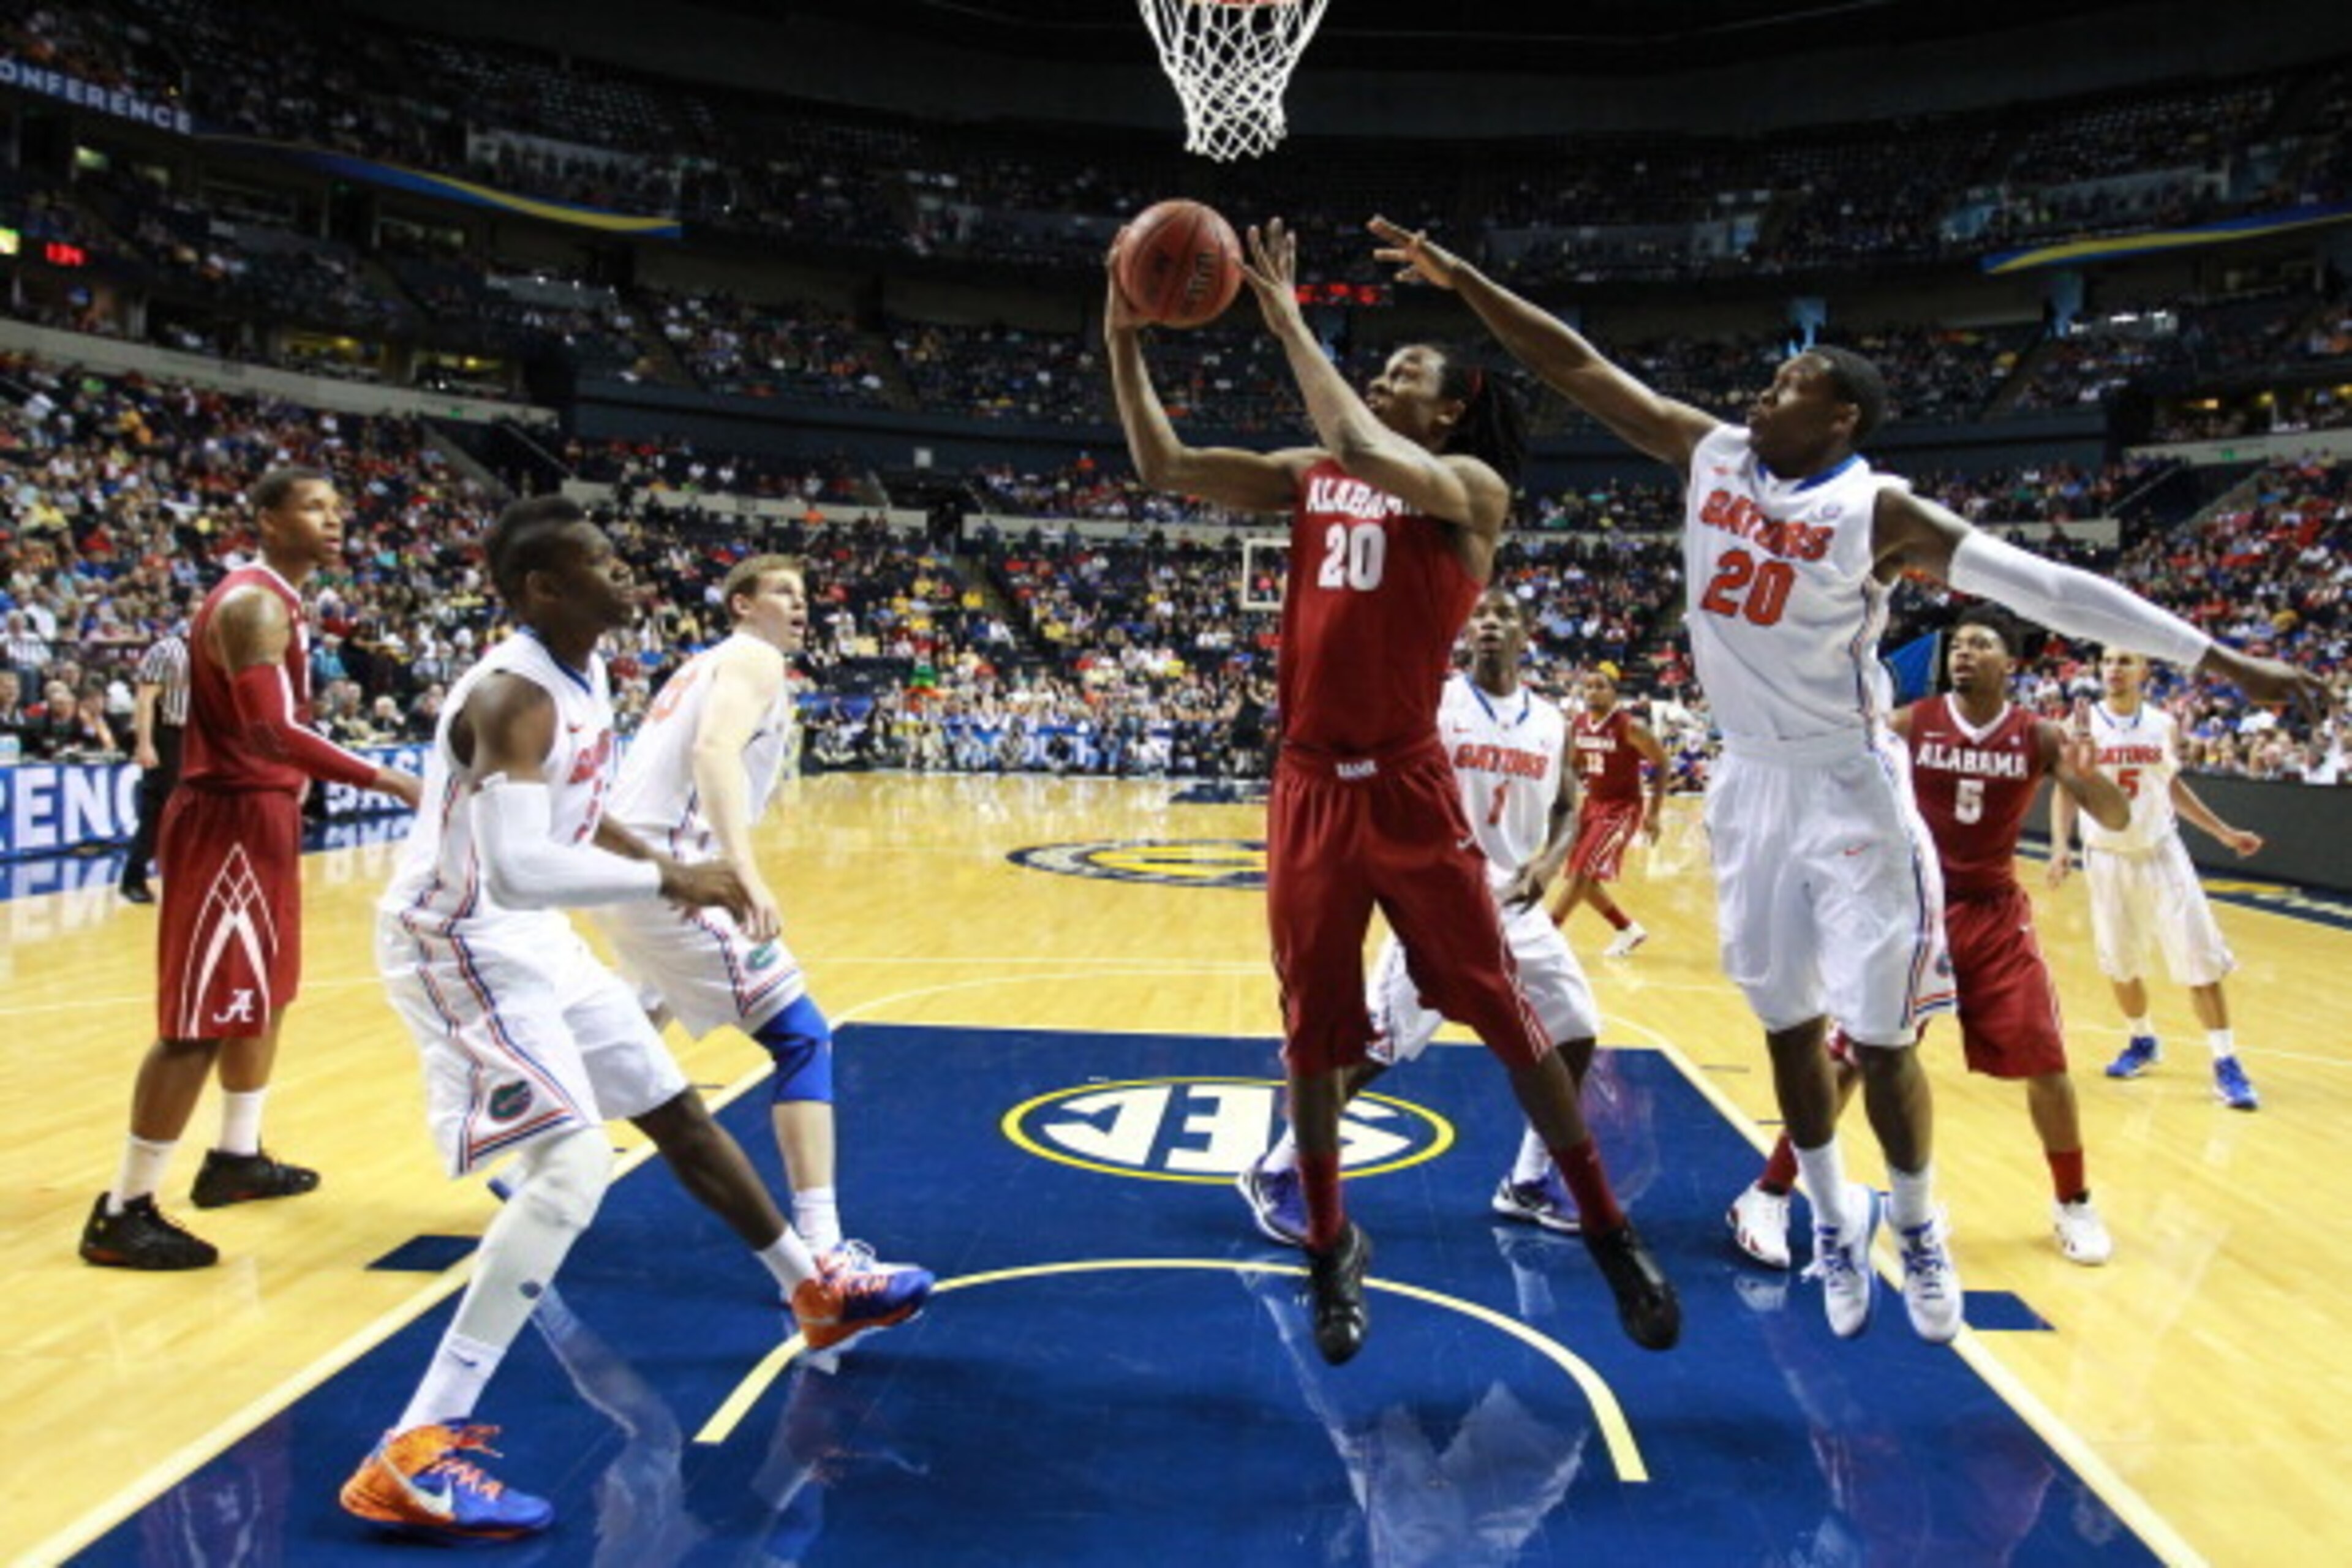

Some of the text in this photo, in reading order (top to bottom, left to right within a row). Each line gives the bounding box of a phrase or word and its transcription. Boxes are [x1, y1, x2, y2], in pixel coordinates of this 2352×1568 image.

[1699, 488, 1833, 562] GATORS
[1317, 522, 1388, 590] 20
[1698, 547, 1796, 626] 20
[1453, 744, 1548, 782] GATORS
[1915, 741, 2030, 780] ALABAMA
[1487, 779, 1509, 827] 1
[1954, 778, 1985, 825] 5
